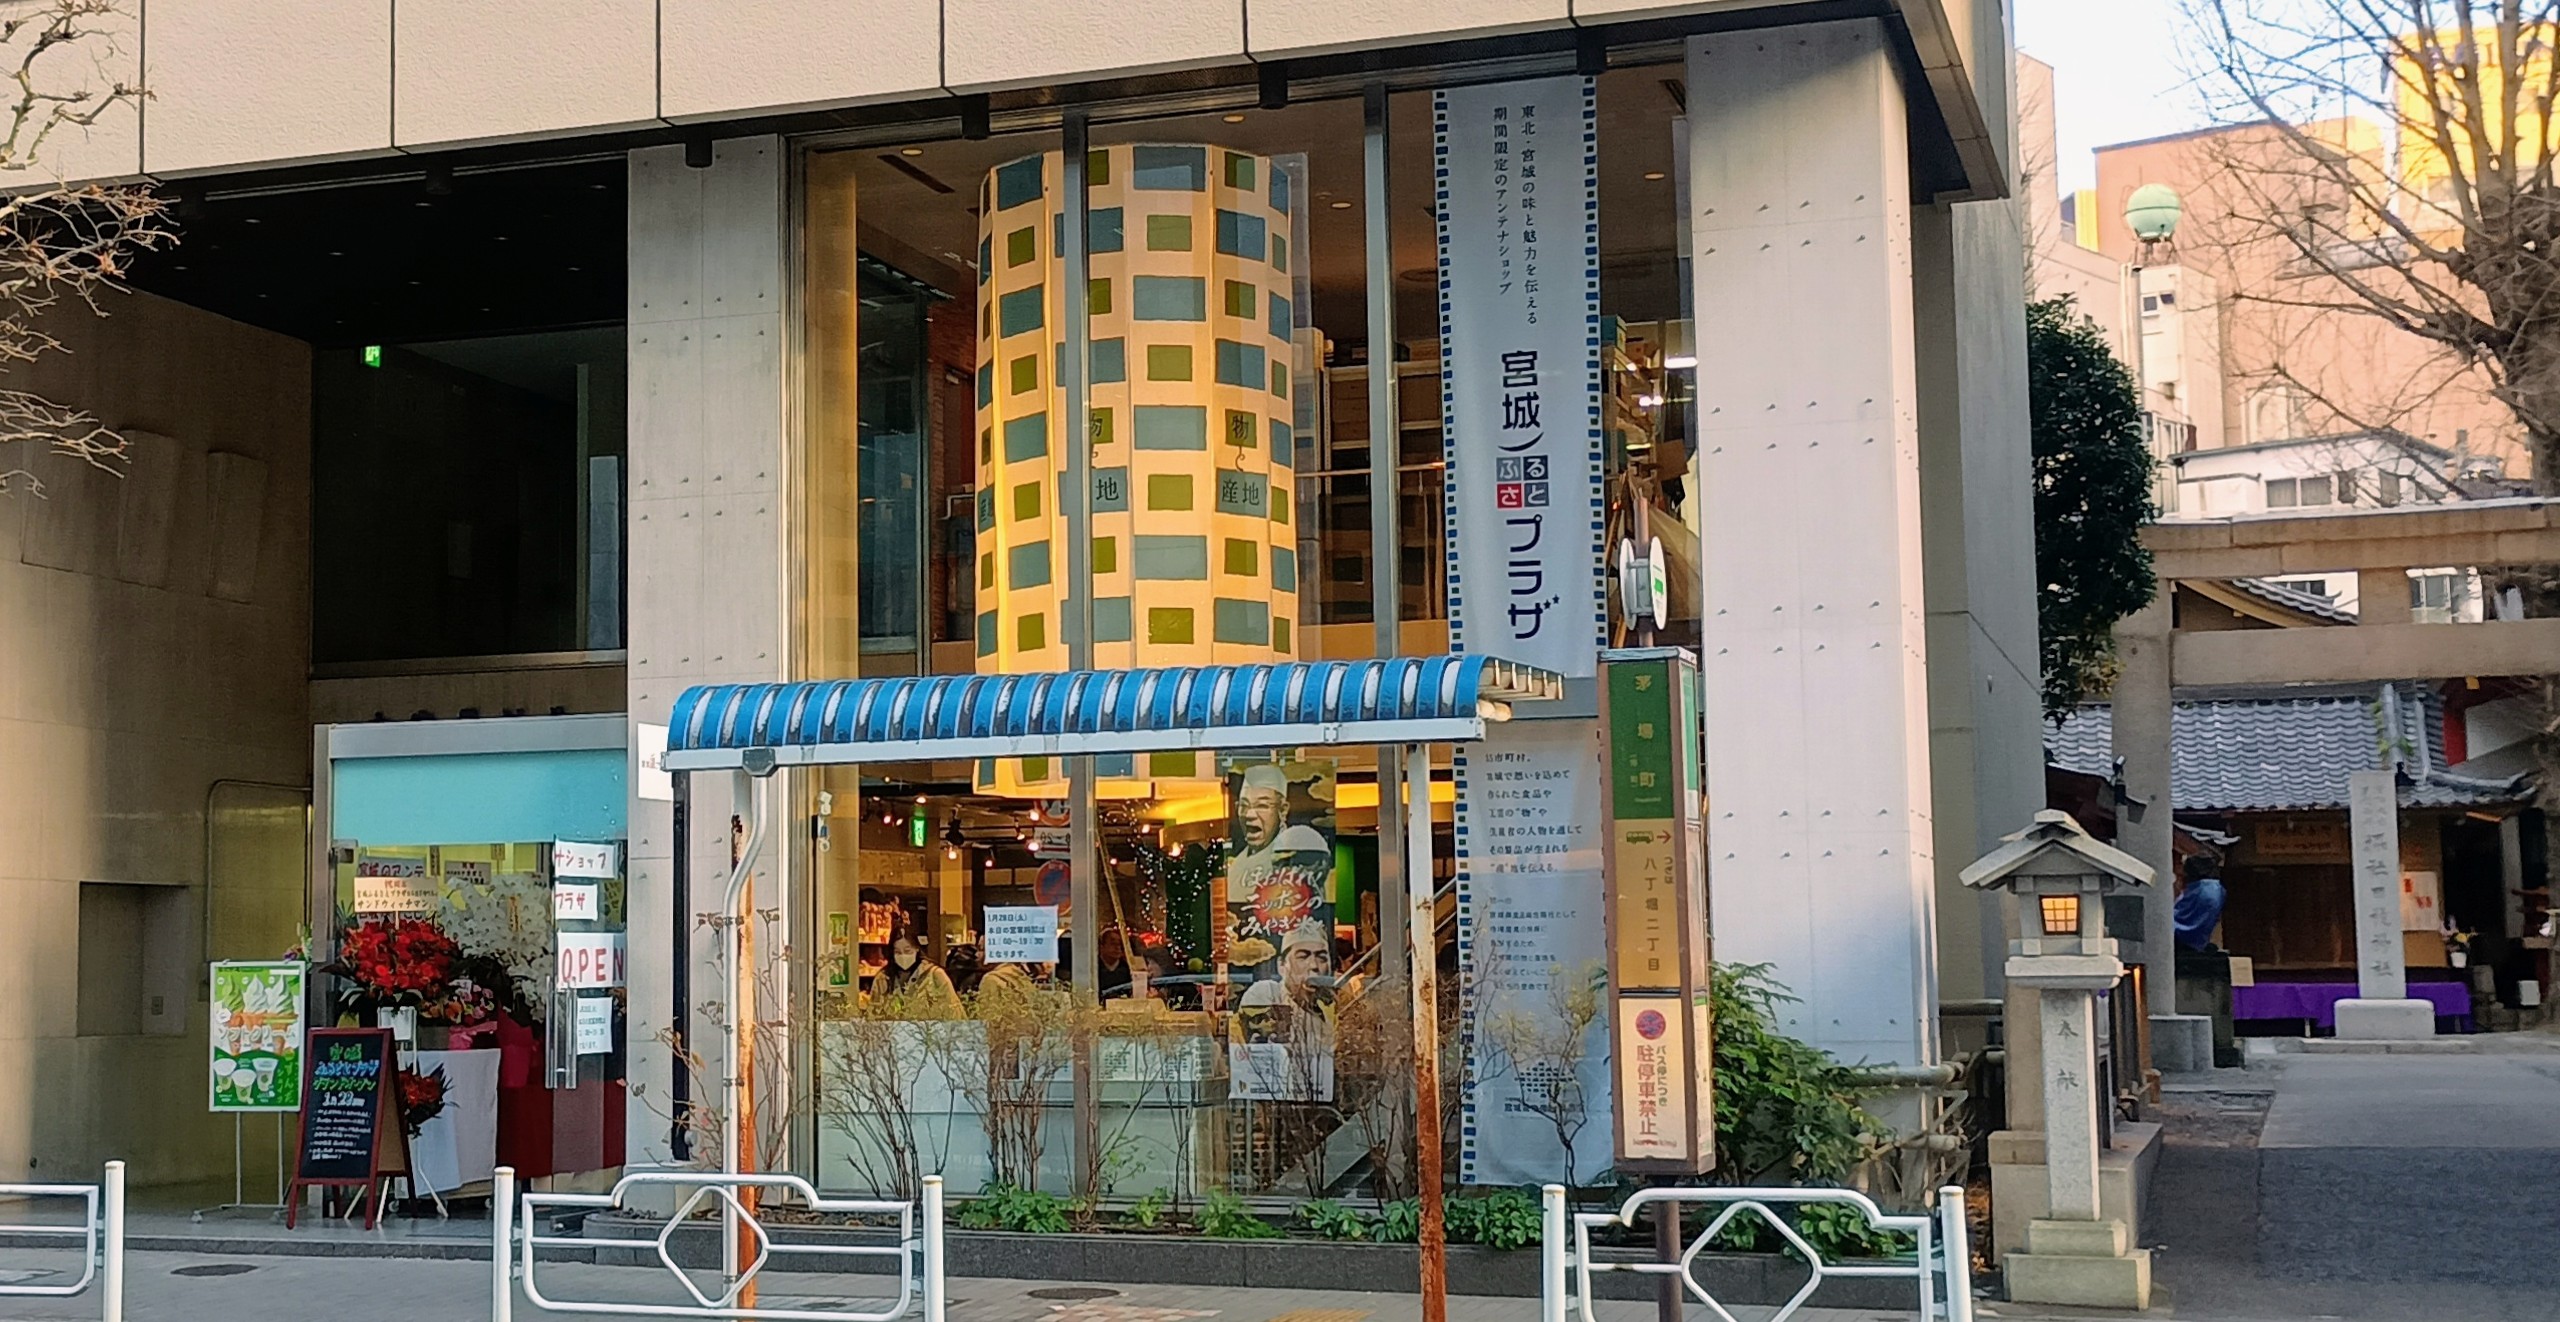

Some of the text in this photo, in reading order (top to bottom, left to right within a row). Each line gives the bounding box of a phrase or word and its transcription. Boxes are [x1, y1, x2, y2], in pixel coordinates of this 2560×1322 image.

[1493, 107, 1513, 295] 期間限定のアンテナショップ
[1521, 105, 1539, 325] 東北・宮城の味と魅力を伝える
[1095, 477, 1119, 501] 地
[1221, 478, 1260, 506] 産地
[1240, 889, 1323, 912] ニッポンの
[1644, 857, 1660, 971] 八丁堀二丁目
[562, 948, 625, 983] OPEN
[218, 1026, 296, 1041] ソフトクリーム
[1637, 1044, 1658, 1136] 駐停車禁止
[1655, 1045, 1668, 1107] バス停につき
